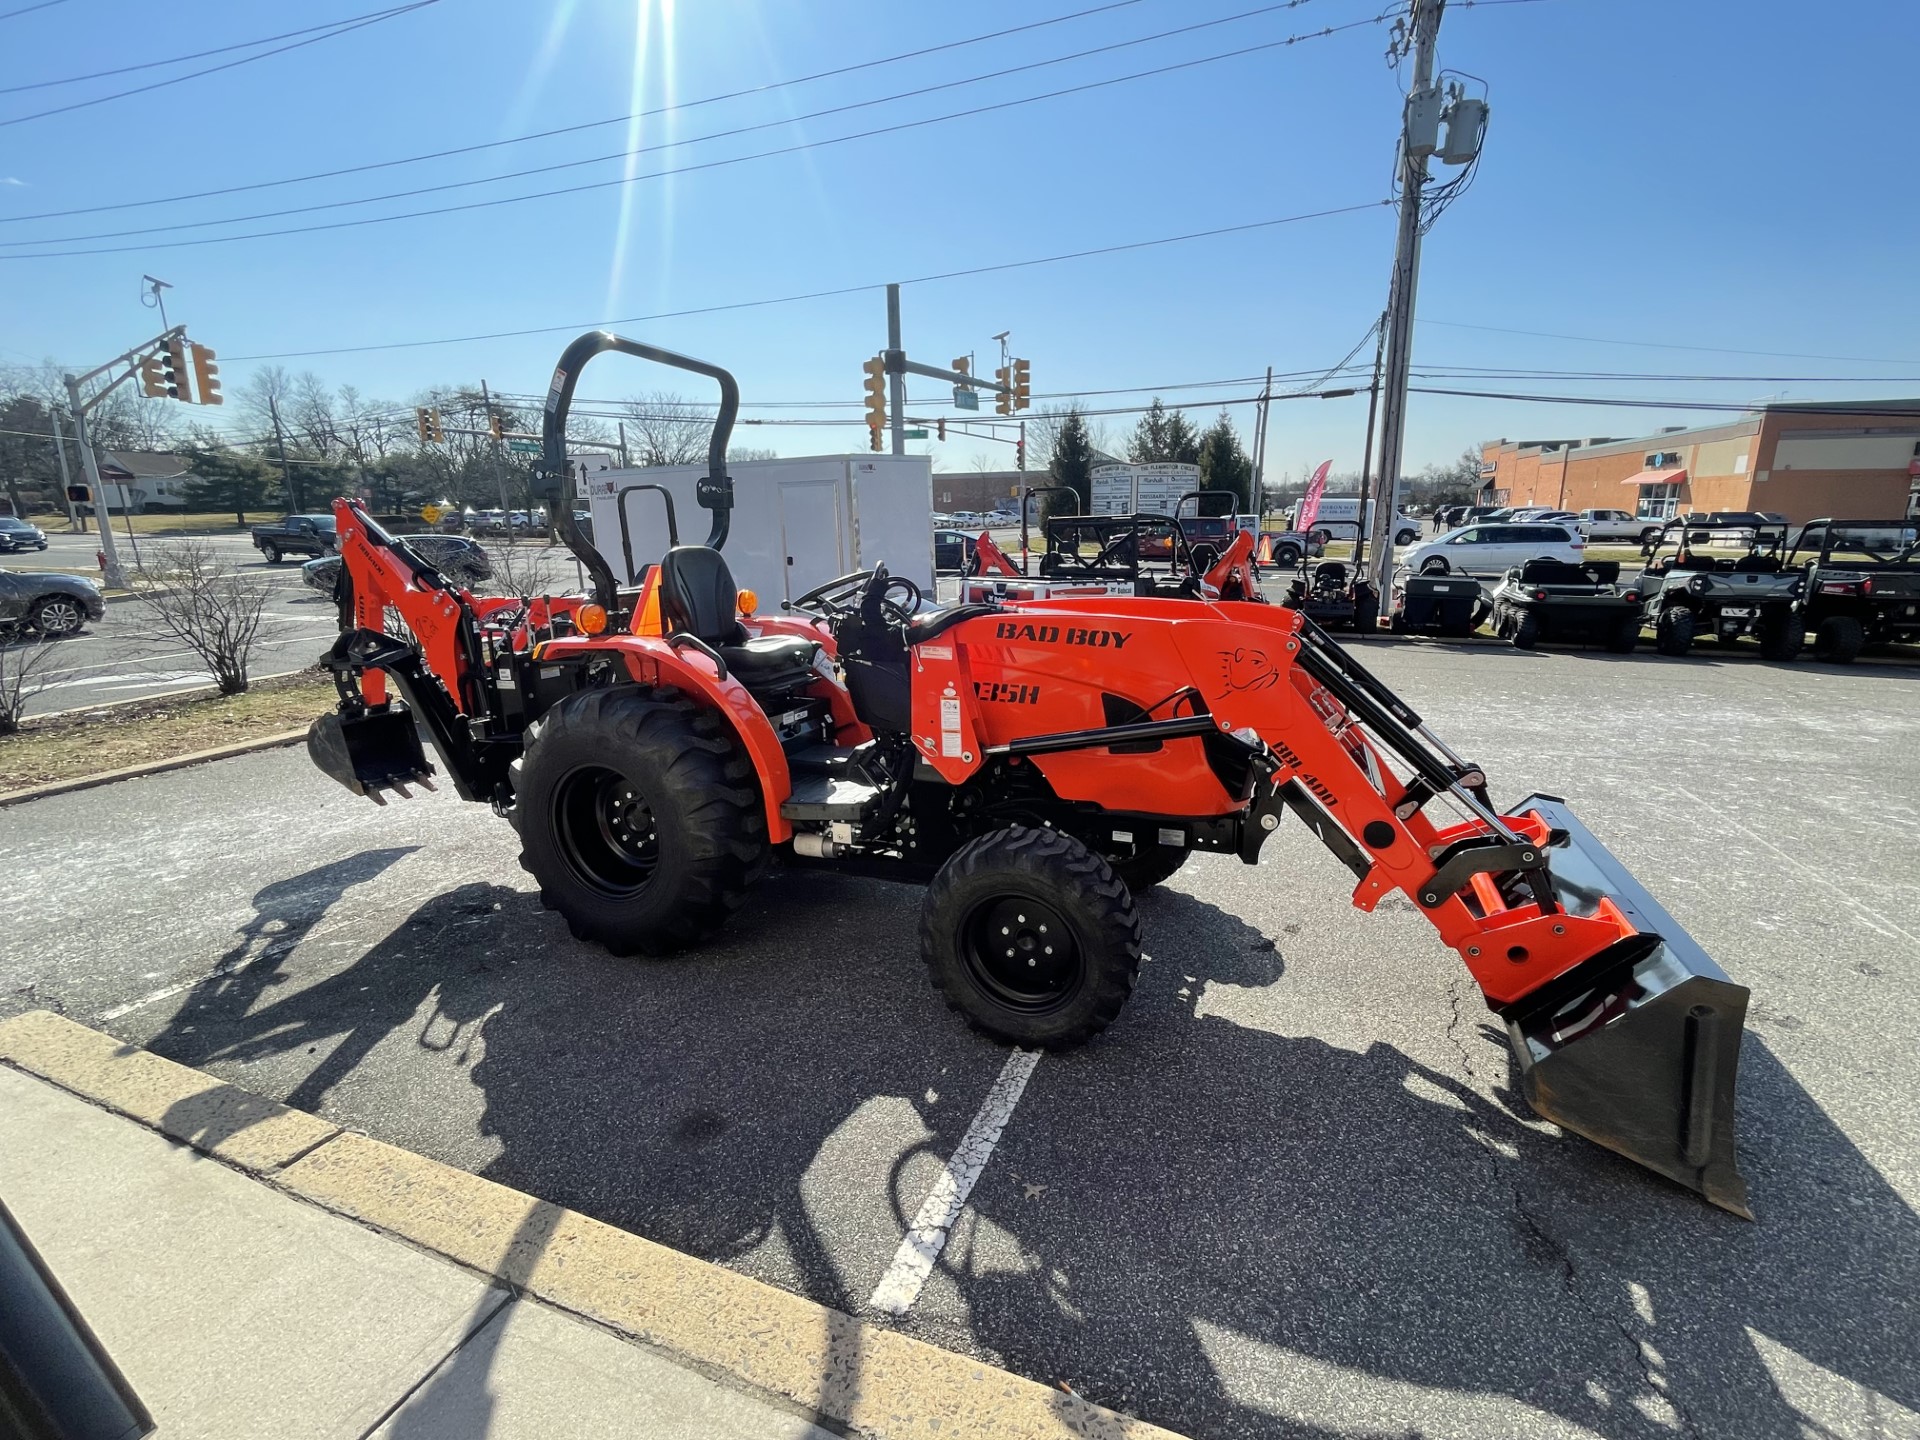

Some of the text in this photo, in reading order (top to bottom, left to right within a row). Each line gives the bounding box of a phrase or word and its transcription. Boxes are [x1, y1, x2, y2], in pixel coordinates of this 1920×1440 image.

[1300, 505, 1309, 529] NOW
[996, 622, 1133, 649] BAD BOY
